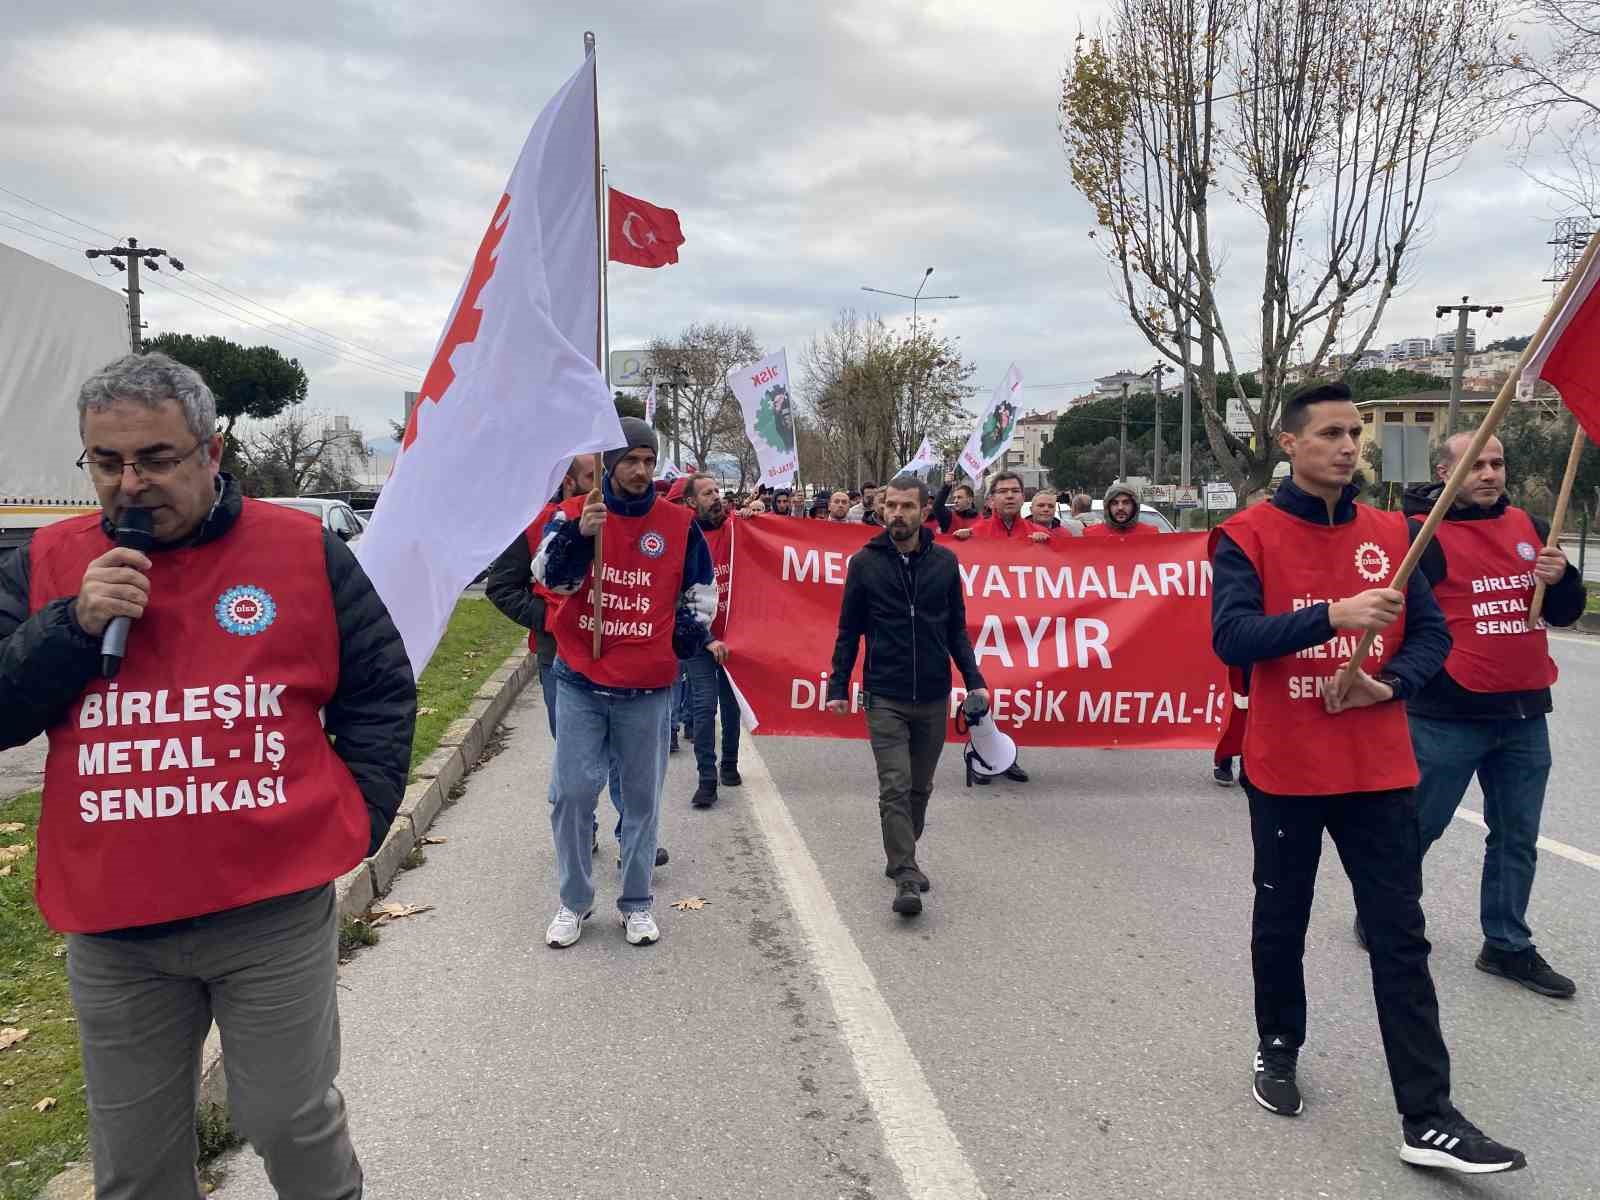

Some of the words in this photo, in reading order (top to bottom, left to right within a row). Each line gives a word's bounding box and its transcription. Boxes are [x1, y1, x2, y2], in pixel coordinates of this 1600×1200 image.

[782, 545, 851, 585] MES
[1472, 598, 1529, 617] METAL
[79, 675, 287, 729] BİRLEŞİK
[78, 736, 216, 776] METAL
[254, 724, 286, 771] İŞ
[79, 776, 288, 823] SENDİKASI
